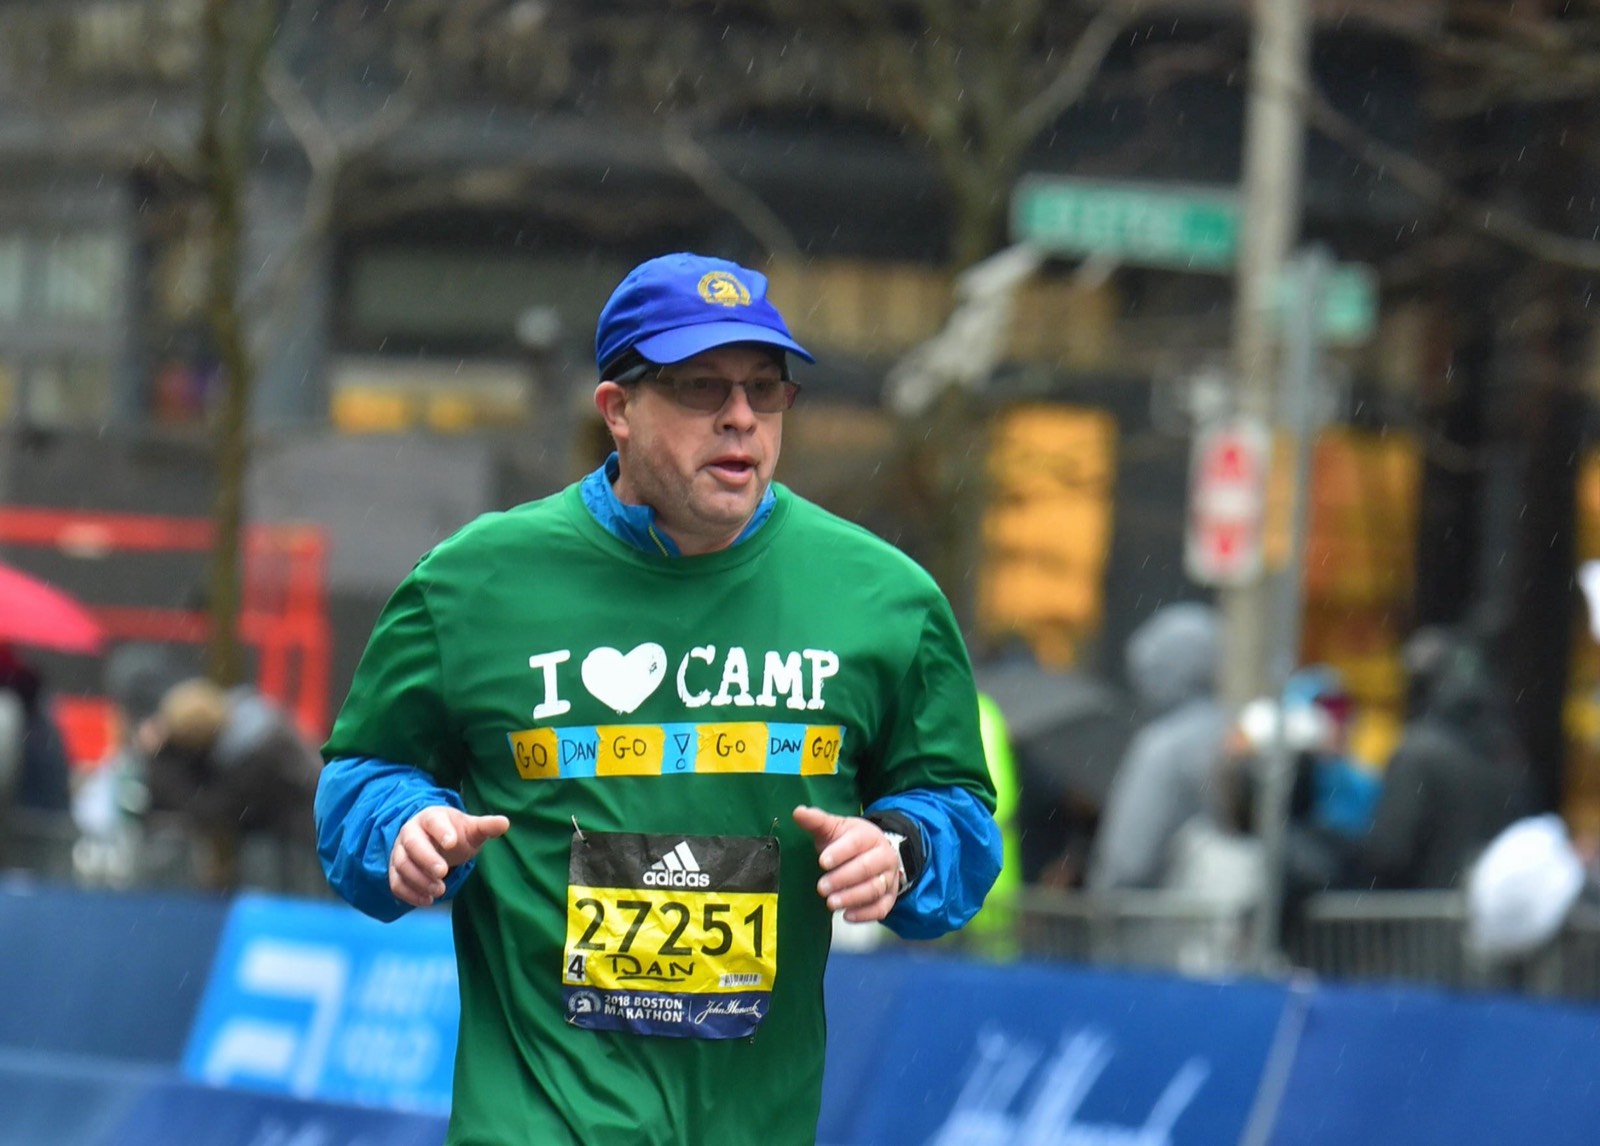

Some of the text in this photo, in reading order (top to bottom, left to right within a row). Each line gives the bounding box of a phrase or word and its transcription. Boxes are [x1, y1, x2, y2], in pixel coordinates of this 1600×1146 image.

[529, 644, 840, 719] I CAMP
[517, 742, 548, 768] GO
[562, 739, 597, 766] DAN
[613, 739, 648, 759] GO
[771, 738, 802, 755] DAN
[642, 869, 710, 887] adidas
[574, 898, 764, 958] 27251
[568, 955, 585, 979] 4
[605, 954, 696, 977] DAN
[604, 995, 631, 1007] 2018
[633, 996, 683, 1010] BOSTON
[604, 1005, 684, 1023] MARATHON
